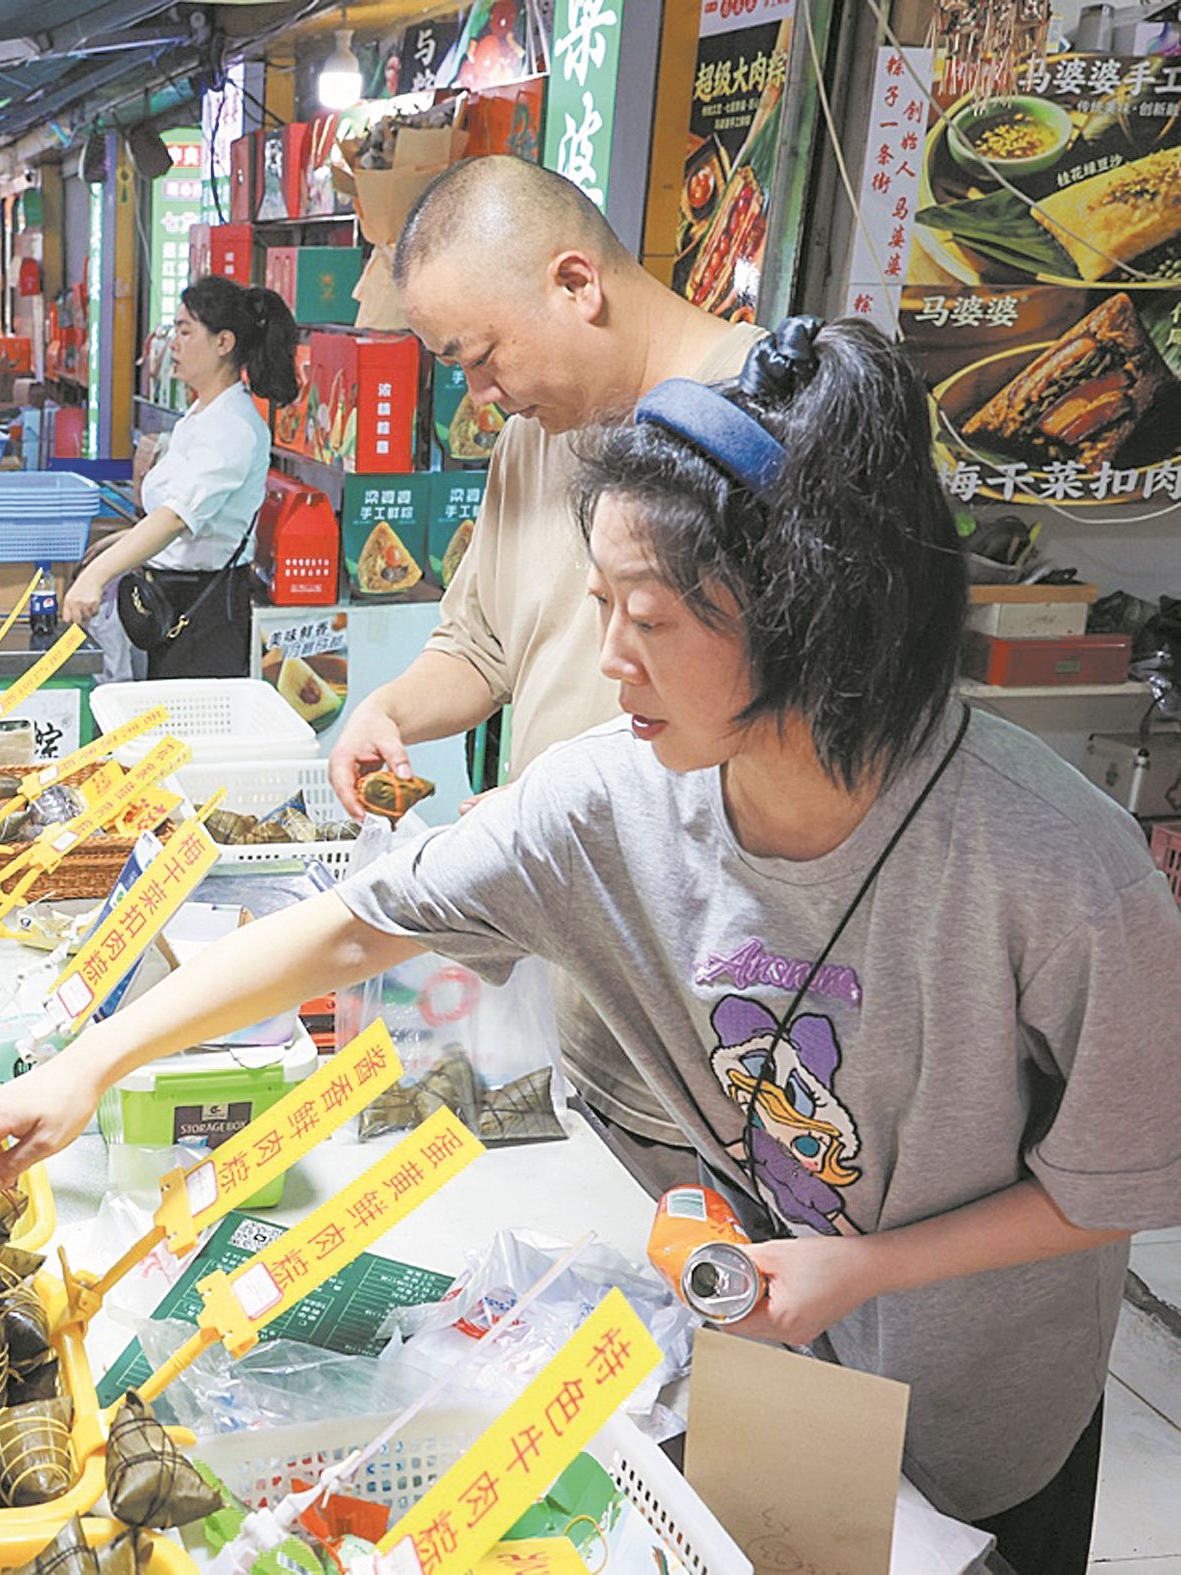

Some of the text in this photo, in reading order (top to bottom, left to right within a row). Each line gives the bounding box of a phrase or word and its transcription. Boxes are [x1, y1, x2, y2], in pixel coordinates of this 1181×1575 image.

[693, 48, 788, 102] 超级大肉粽
[871, 55, 905, 194] 粽子一条街
[884, 101, 923, 277] 创始人 马婆婆
[1056, 154, 1123, 187] 桂花绿豆沙
[915, 294, 1019, 328] 马婆婆
[939, 460, 1181, 502] 梅干菜扣肉
[82, 832, 206, 986] 梅干菜扣肉粽
[180, 1121, 225, 1134] STORAGE
[215, 1045, 387, 1197] 酱香鲜肉粽
[268, 1125, 465, 1292] 蛋黄鲜肉粽
[414, 1325, 634, 1575] 特色牛肉粽
